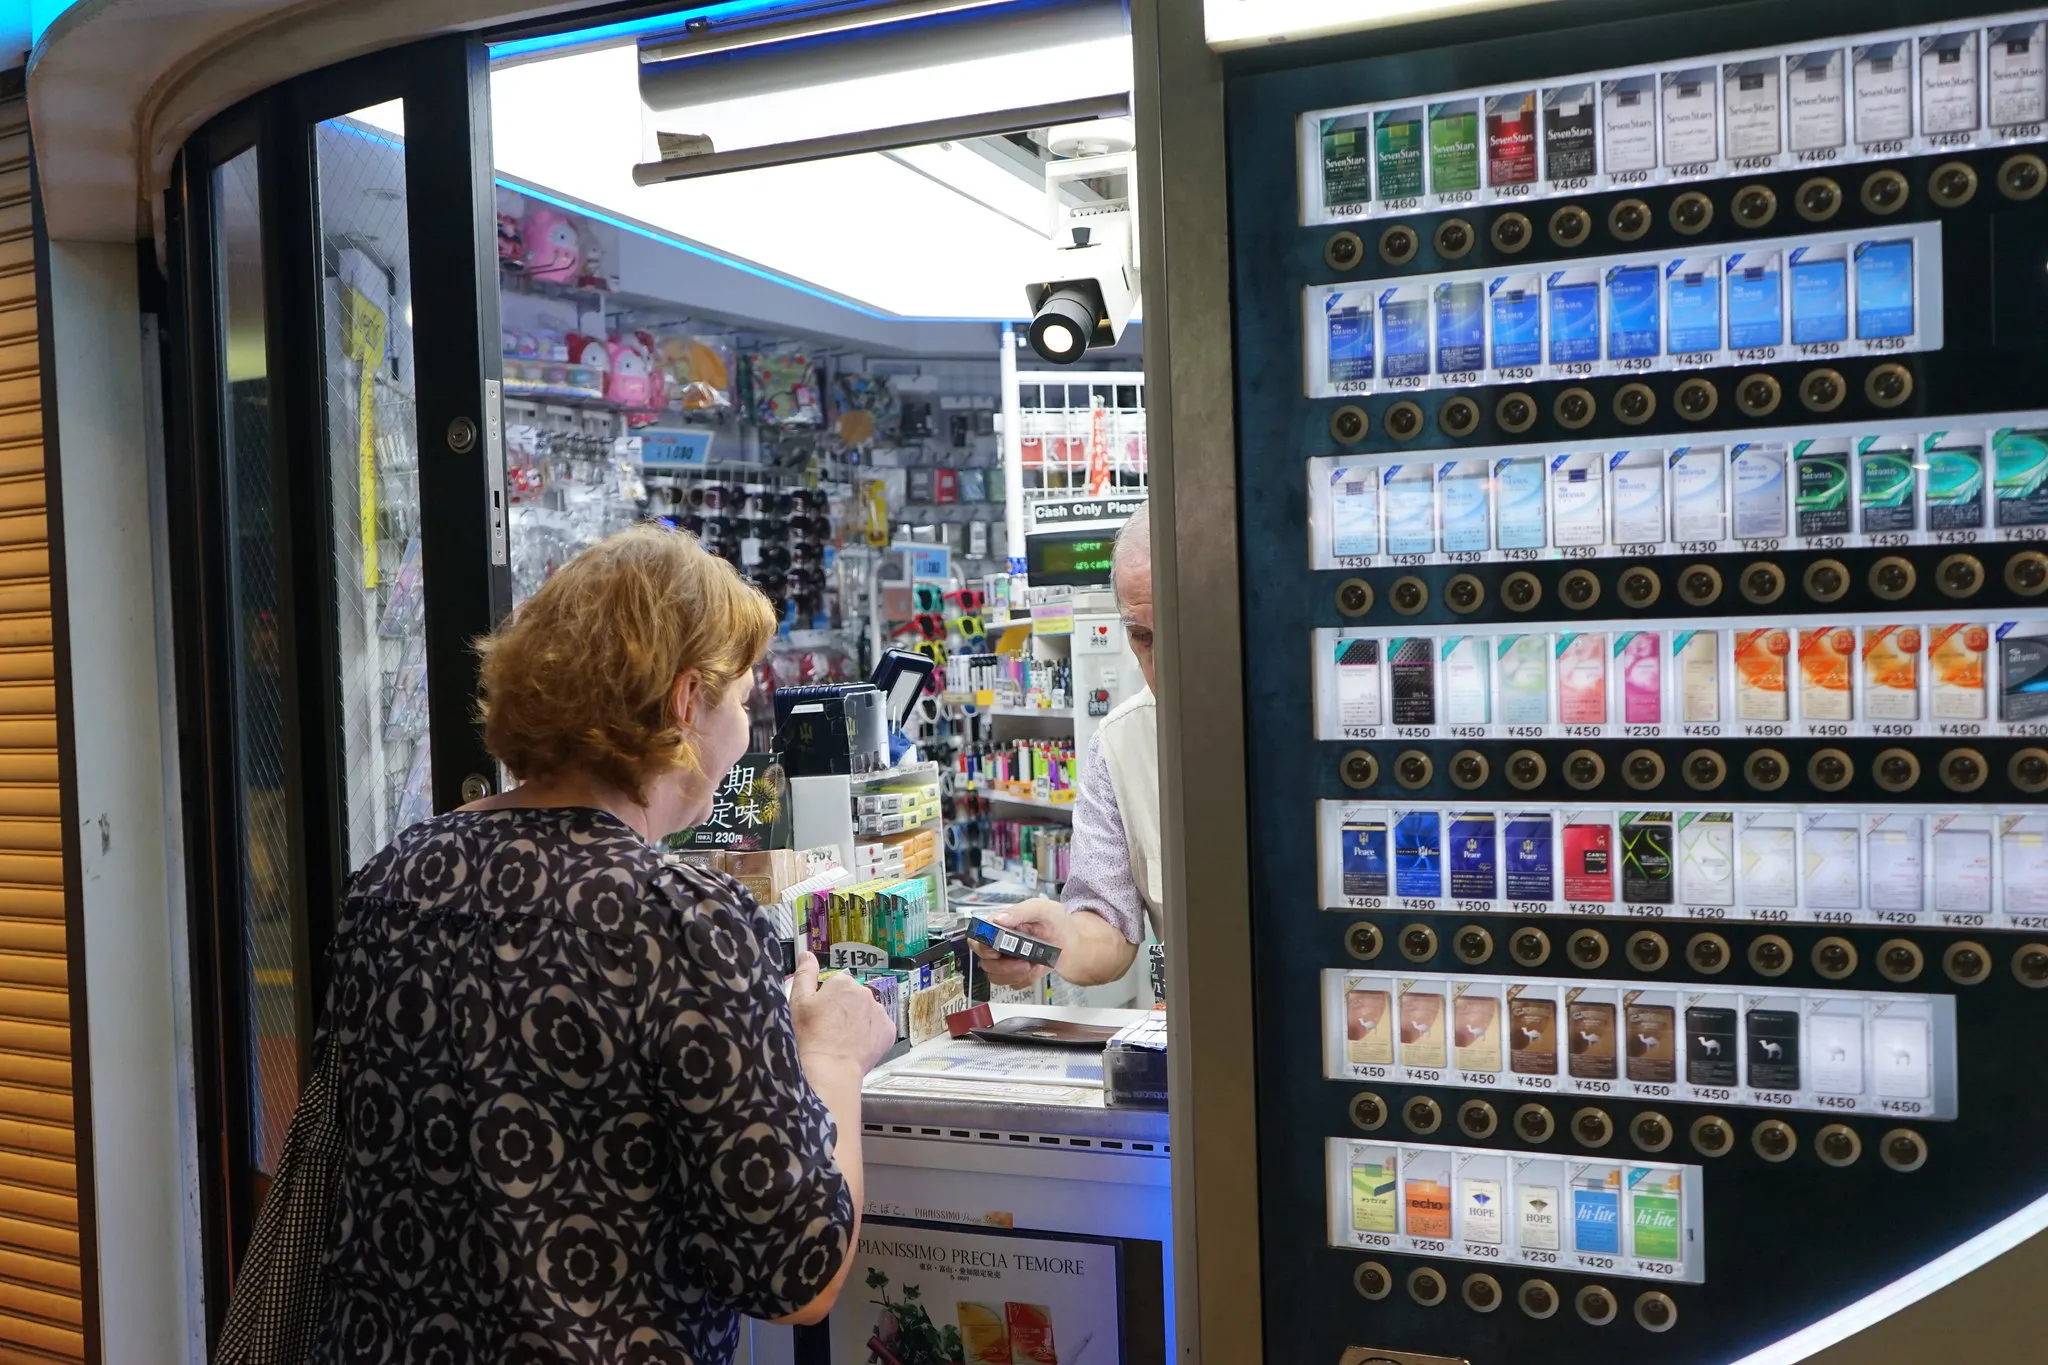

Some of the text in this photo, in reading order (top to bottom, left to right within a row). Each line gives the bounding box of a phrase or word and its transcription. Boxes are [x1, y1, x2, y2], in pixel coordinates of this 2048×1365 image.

[1548, 126, 1592, 140] SevenStars
[2000, 124, 2040, 138] ¥460
[1490, 132, 1534, 146] SevenStars
[1930, 132, 1970, 146] ¥460
[1864, 140, 1904, 154] ¥460
[1798, 148, 1836, 162] ¥460
[1735, 156, 1772, 169] ¥460
[1672, 164, 1708, 176] ¥460
[1612, 170, 1648, 184] ¥460
[1552, 177, 1588, 190] ¥460
[1439, 190, 1472, 203] ¥460
[1494, 184, 1530, 197] ¥460
[1330, 204, 1362, 216] ¥460
[1384, 198, 1417, 210] ¥460
[1801, 342, 1840, 356] ¥430
[1866, 337, 1904, 350] ¥430
[1676, 352, 1712, 366] ¥430
[1737, 348, 1776, 361] ¥430
[1556, 362, 1592, 374] ¥430
[1616, 358, 1652, 370] ¥430
[1442, 371, 1476, 384] ¥430
[1500, 366, 1534, 380] ¥430
[1334, 380, 1366, 392] ¥430
[1388, 376, 1420, 388] ¥430
[1035, 506, 1068, 518] Cash
[1072, 503, 1102, 516] Only
[1870, 533, 1909, 546] ¥430
[1936, 530, 1976, 544] ¥430
[2004, 528, 2046, 542] ¥430
[1680, 541, 1717, 554] ¥430
[1742, 539, 1779, 552] ¥430
[1806, 536, 1844, 549] ¥430
[1504, 548, 1538, 561] ¥430
[1561, 546, 1596, 558] ¥430
[1620, 544, 1656, 556] ¥430
[1340, 556, 1372, 568] ¥430
[1392, 554, 1426, 566] ¥430
[1448, 551, 1480, 564] ¥430
[1344, 726, 1376, 738] ¥450
[1397, 726, 1430, 738] ¥450
[1450, 726, 1485, 738] ¥450
[1508, 726, 1542, 738] ¥450
[1564, 726, 1600, 738] ¥450
[1624, 726, 1660, 737] ¥230
[1683, 725, 1720, 736] ¥450
[1745, 725, 1783, 736] ¥490
[1808, 724, 1848, 736] ¥490
[1872, 724, 1912, 736] ¥490
[1939, 724, 1980, 736] ¥490
[2007, 724, 2048, 736] ¥430
[702, 798, 762, 829] 定味
[714, 832, 743, 844] 230円
[1354, 847, 1375, 856] Peace
[1464, 850, 1482, 858] Peace
[1520, 852, 1538, 860] Peace
[1348, 897, 1381, 908] ¥460
[1402, 899, 1436, 910] ¥490
[1456, 900, 1490, 912] ¥500
[1512, 902, 1547, 914] ¥500
[1570, 904, 1605, 916] ¥420
[1628, 905, 1664, 917] ¥420
[1688, 908, 1724, 920] ¥420
[1751, 910, 1788, 922] ¥440
[1813, 912, 1852, 924] ¥440
[1876, 912, 1916, 924] ¥420
[1942, 914, 1984, 926] ¥420
[1353, 1066, 1386, 1078] ¥450
[1406, 1069, 1440, 1081] ¥450
[1462, 1072, 1496, 1084] ¥450
[1517, 1076, 1552, 1089] ¥450
[1575, 1080, 1610, 1092] ¥450
[1634, 1084, 1670, 1096] ¥450
[1693, 1087, 1730, 1100] ¥450
[1754, 1092, 1792, 1105] ¥450
[1817, 1096, 1856, 1109] ¥450
[1881, 1100, 1920, 1113] ¥450
[862, 1200, 906, 1216] たばこ。
[914, 1207, 960, 1220] PIANISSIMO
[1412, 1198, 1444, 1210] echo
[1469, 1207, 1496, 1218] HOPE
[1526, 1213, 1552, 1224] HOPE
[1578, 1203, 1616, 1222] hi-lite
[1636, 1210, 1676, 1227] hi-lite
[1357, 1233, 1390, 1246] ¥260
[1412, 1238, 1444, 1252] ¥250
[858, 1238, 1085, 1276] PIANISSIMO PRECIA TEMORE
[1465, 1244, 1499, 1258] ¥230
[1522, 1250, 1556, 1263] ¥230
[1578, 1256, 1614, 1269] ¥420
[1637, 1261, 1673, 1274] ¥420
